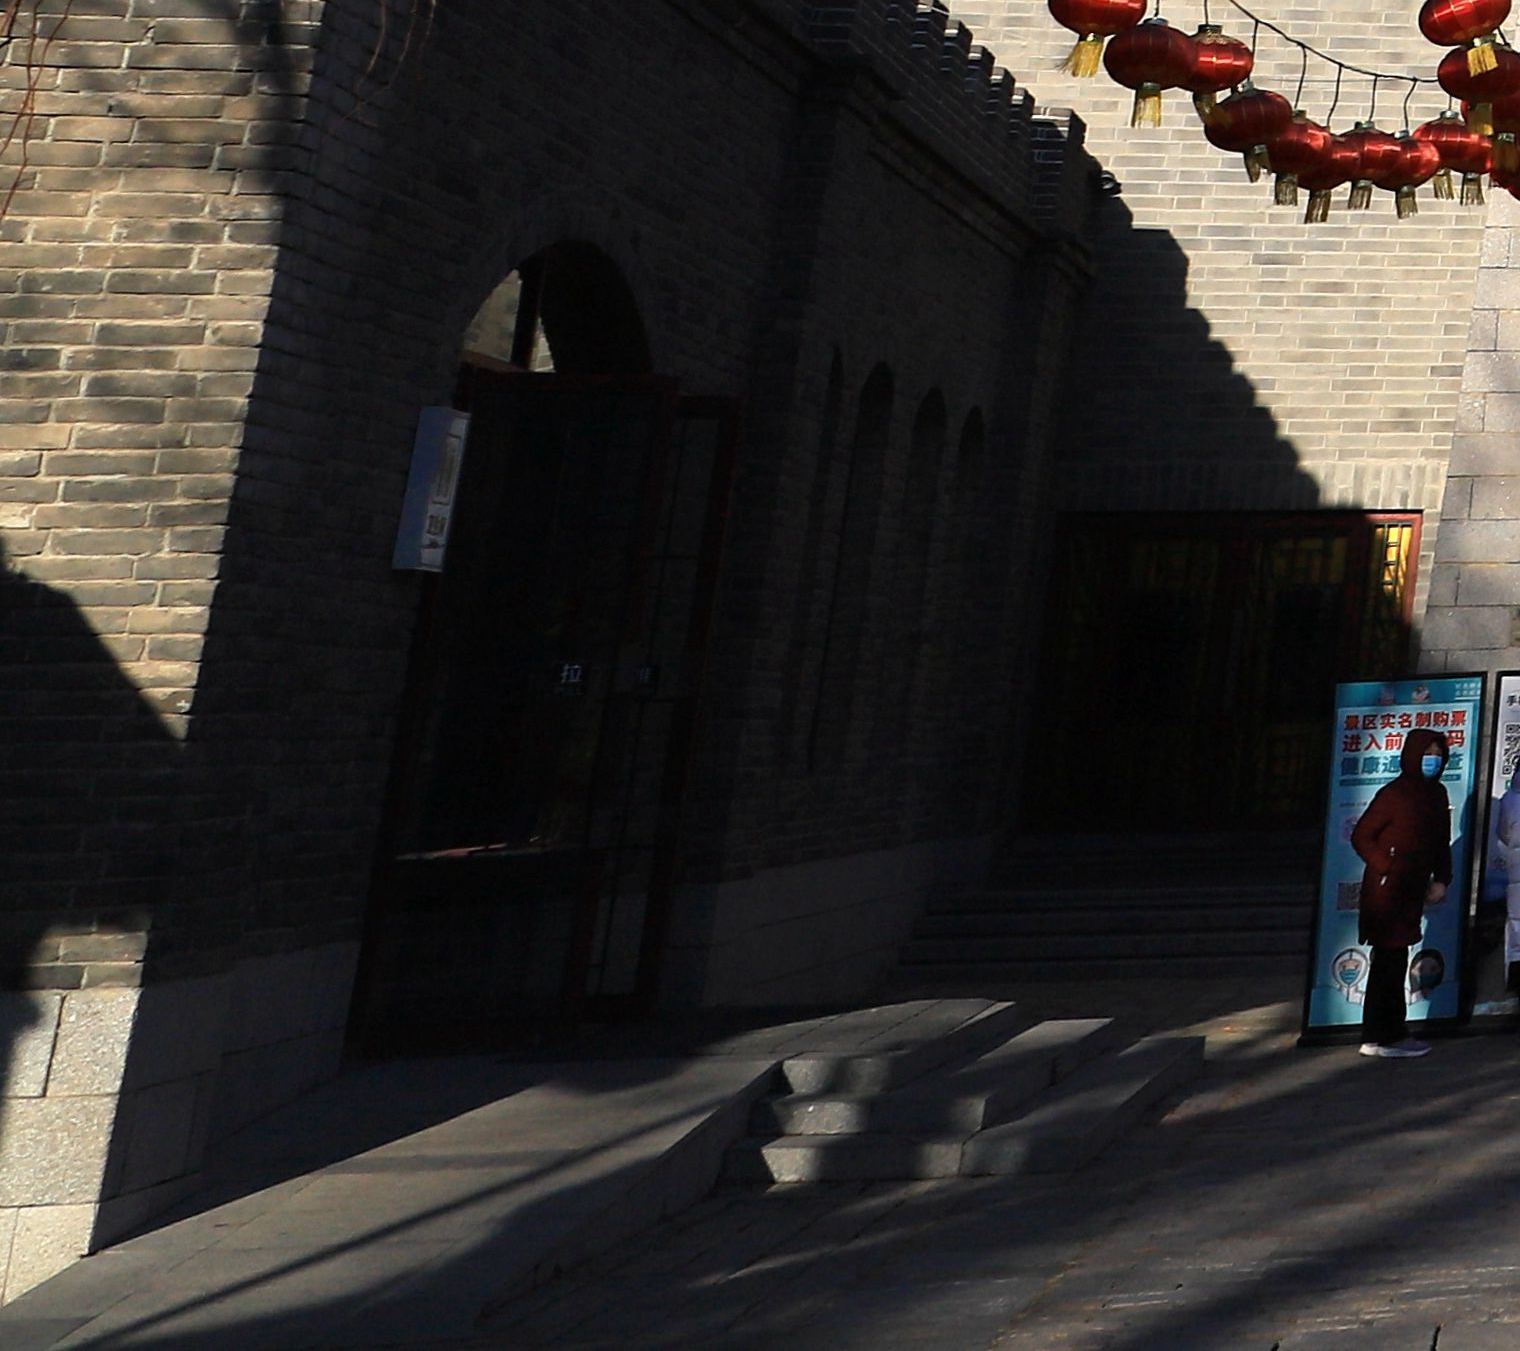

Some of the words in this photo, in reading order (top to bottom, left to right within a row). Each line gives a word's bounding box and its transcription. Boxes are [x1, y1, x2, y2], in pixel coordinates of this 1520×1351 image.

[1344, 710, 1468, 730] 景区实名制购票
[1342, 730, 1465, 752] 进入前码
[1341, 752, 1463, 775] 健康通查
